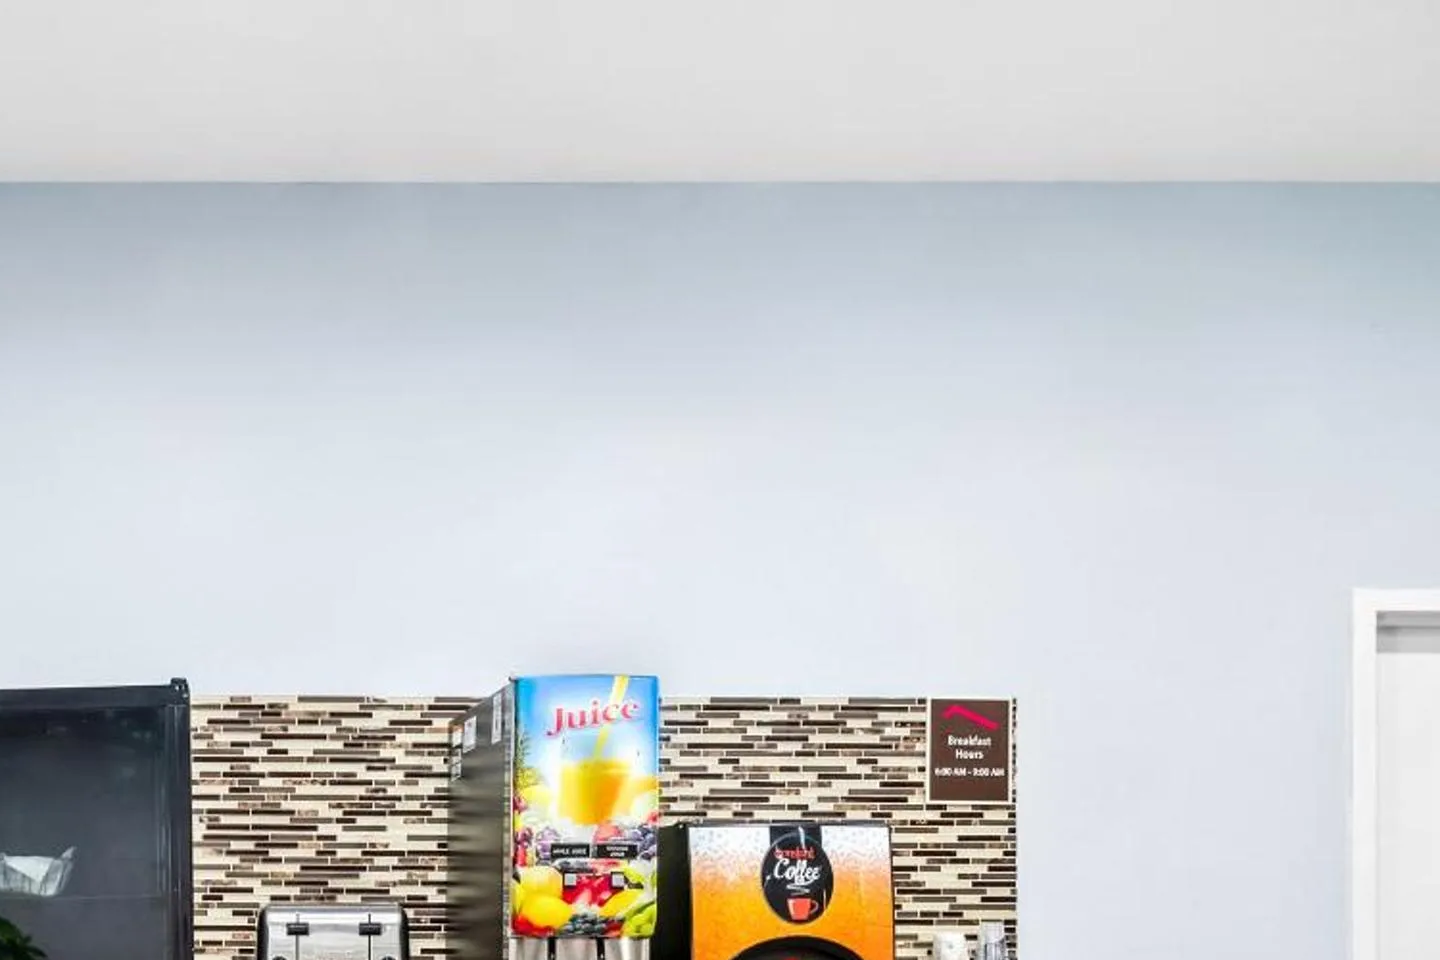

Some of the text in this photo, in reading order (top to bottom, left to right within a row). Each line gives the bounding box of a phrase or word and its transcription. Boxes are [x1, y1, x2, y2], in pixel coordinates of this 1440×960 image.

[546, 698, 640, 738] Juice
[947, 734, 992, 746] Breakfast
[955, 748, 984, 759] Hours
[990, 767, 1005, 777] AM
[773, 858, 821, 885] Coffee
